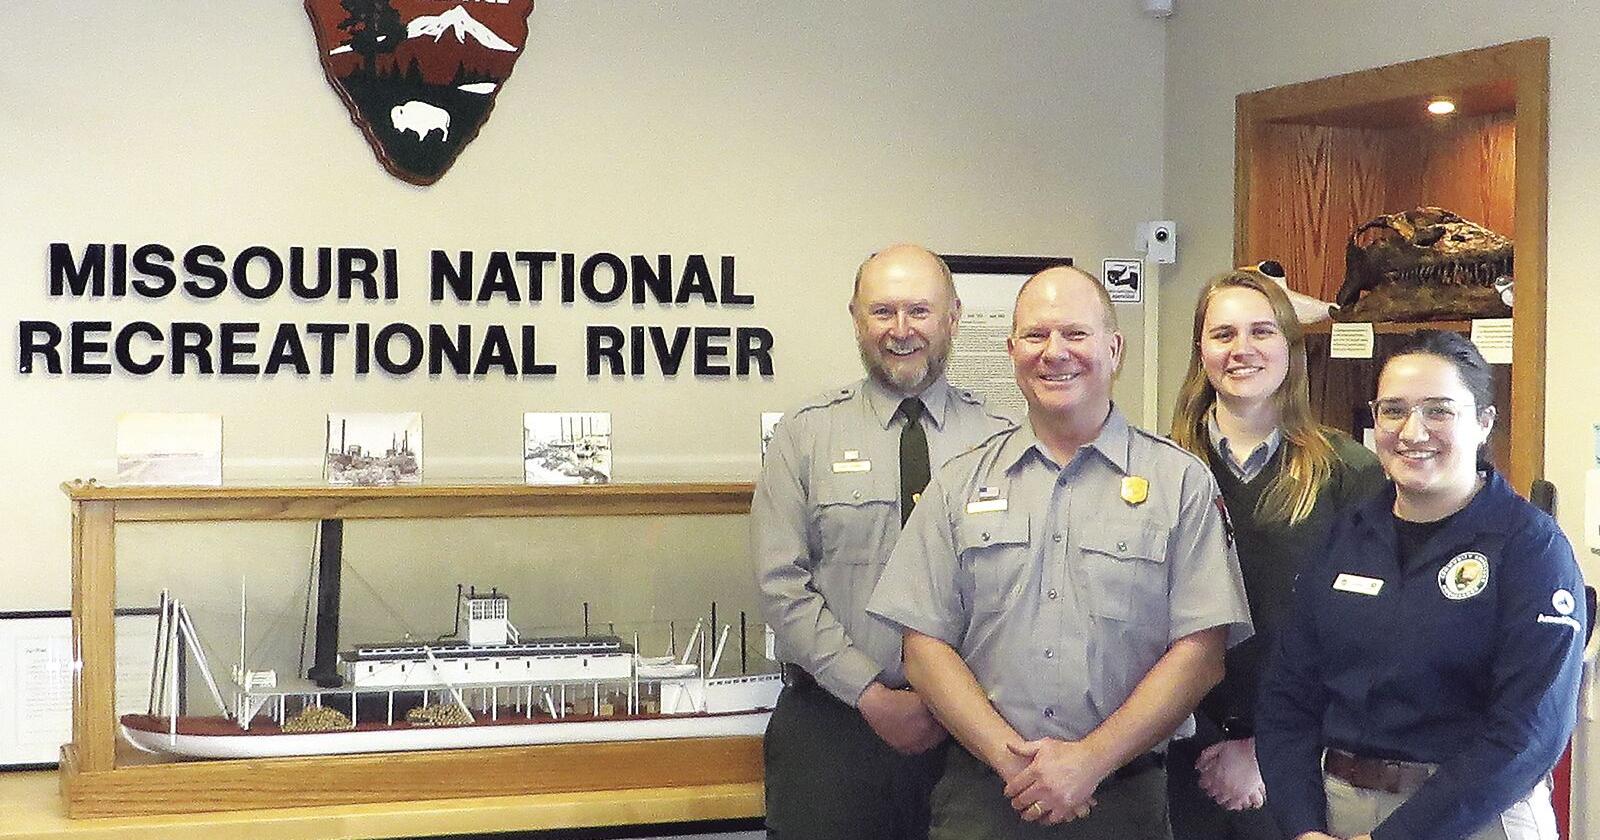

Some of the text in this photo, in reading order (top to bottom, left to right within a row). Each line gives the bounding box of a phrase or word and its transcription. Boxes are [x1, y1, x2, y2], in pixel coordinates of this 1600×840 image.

[49, 242, 755, 305] MISSOURI NATIONAL
[19, 320, 775, 376] RECREATIONAL RIVER
